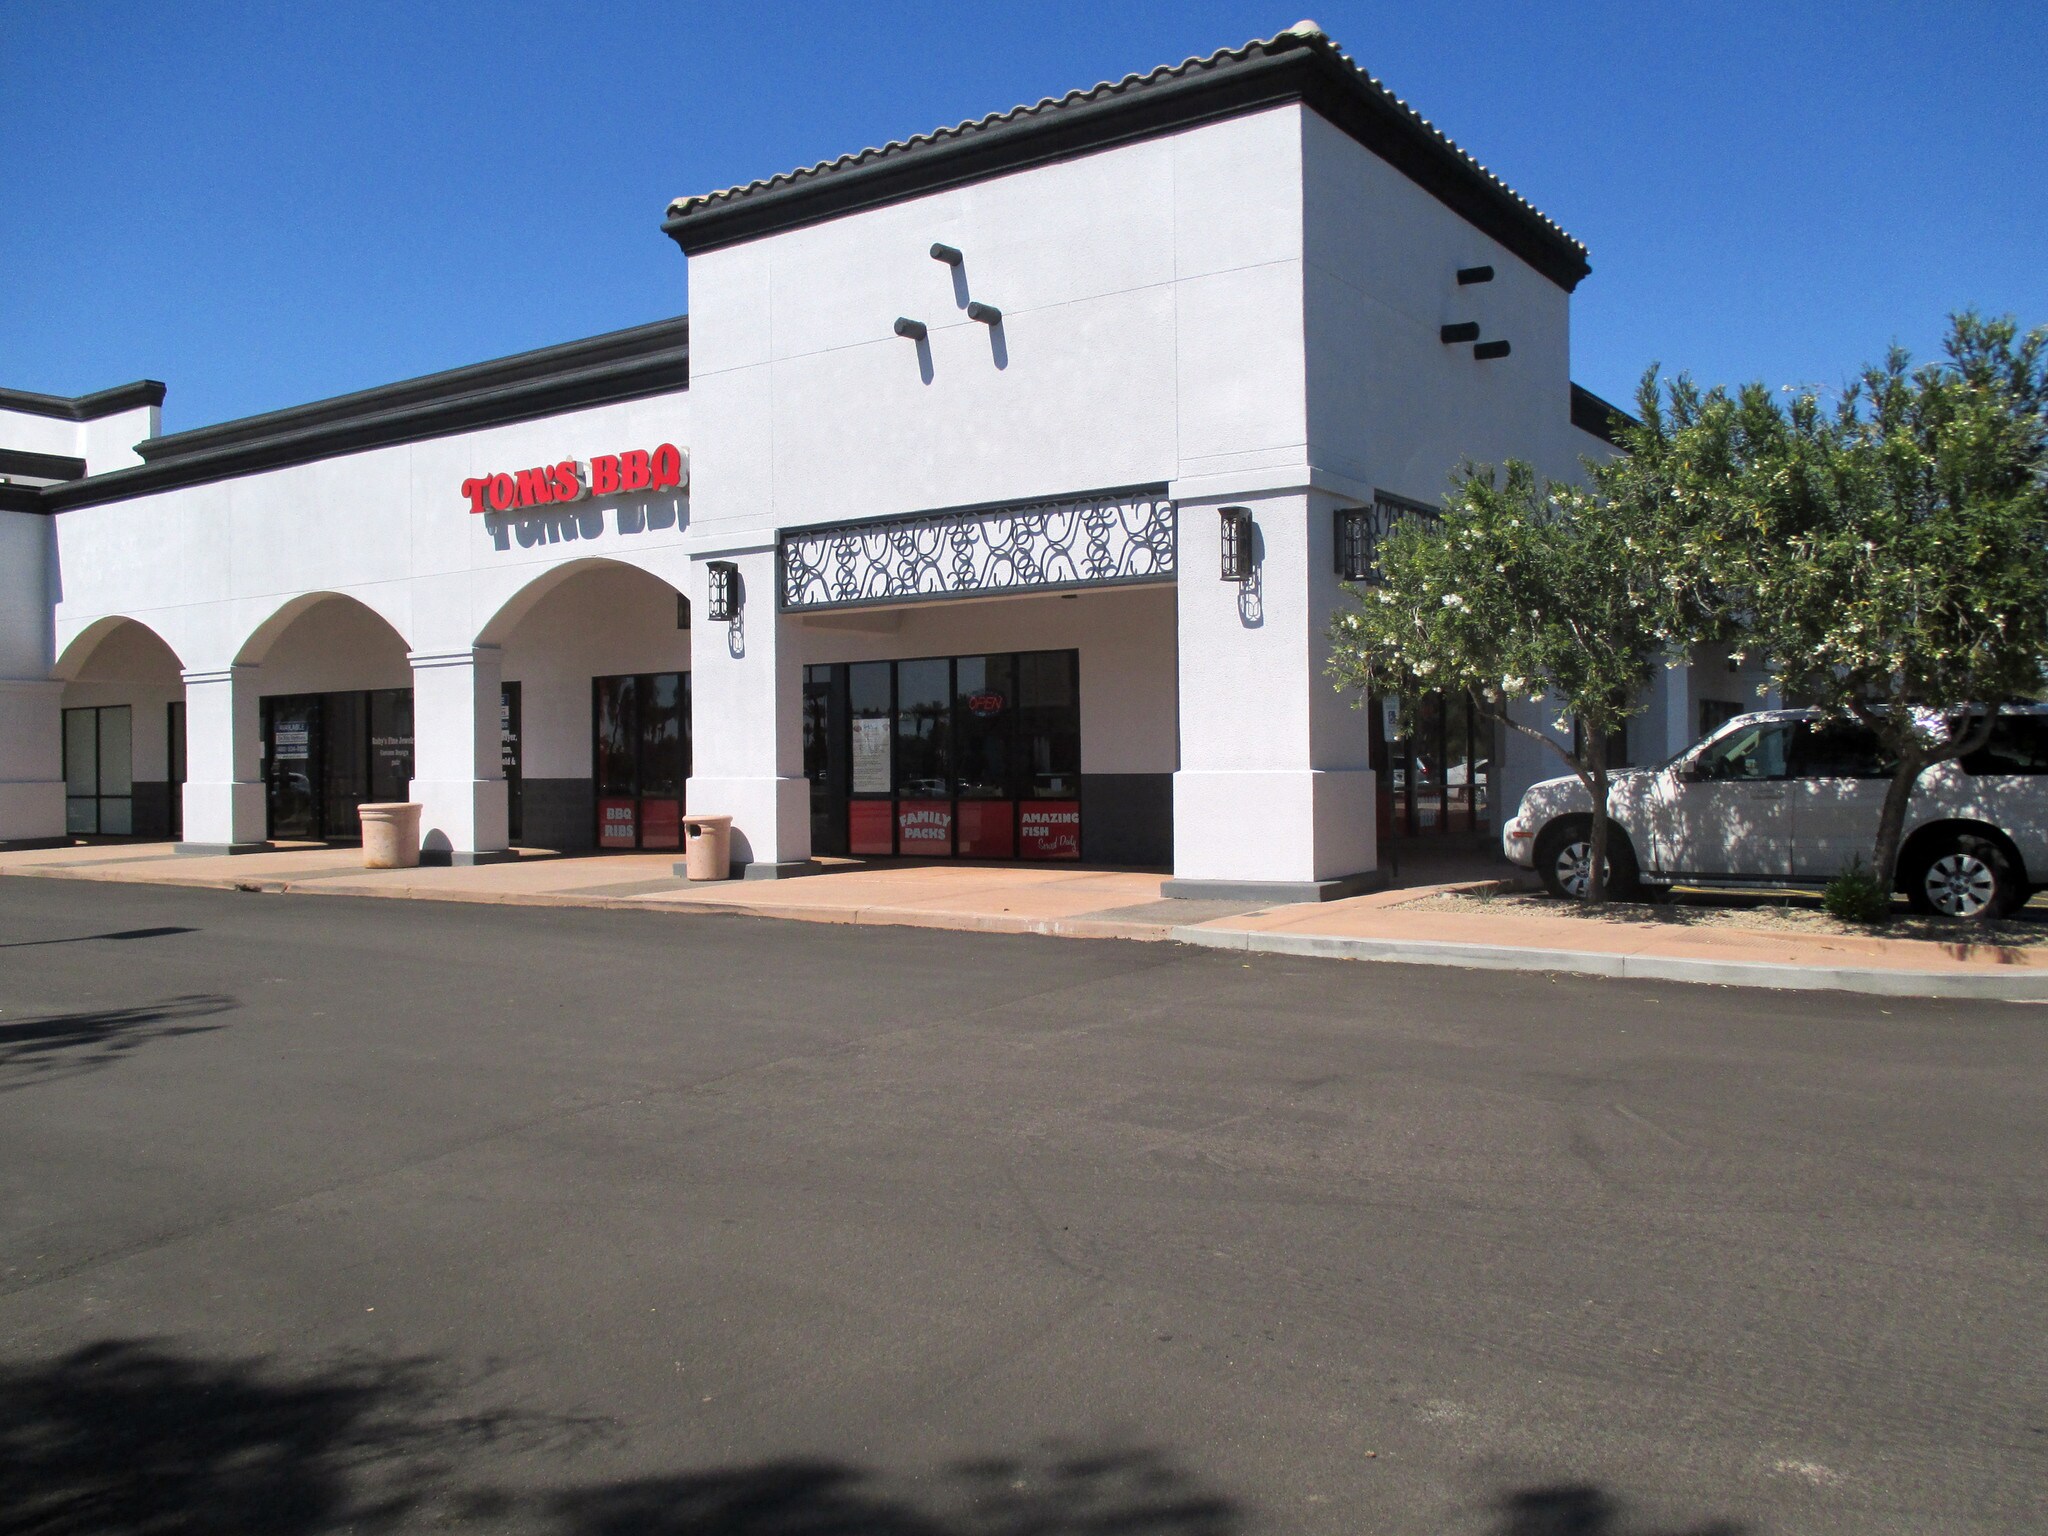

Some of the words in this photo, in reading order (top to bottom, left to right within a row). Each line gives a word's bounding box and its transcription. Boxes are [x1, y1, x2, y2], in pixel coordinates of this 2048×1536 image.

[461, 461, 579, 514] TOM'S
[590, 443, 681, 496] BBQ
[969, 696, 1003, 710] OPEN
[606, 807, 632, 820] BBQ
[899, 810, 951, 827] FAMILY
[1022, 812, 1079, 823] AMAZING
[604, 824, 634, 837] RIBS
[1022, 826, 1049, 837] FISH
